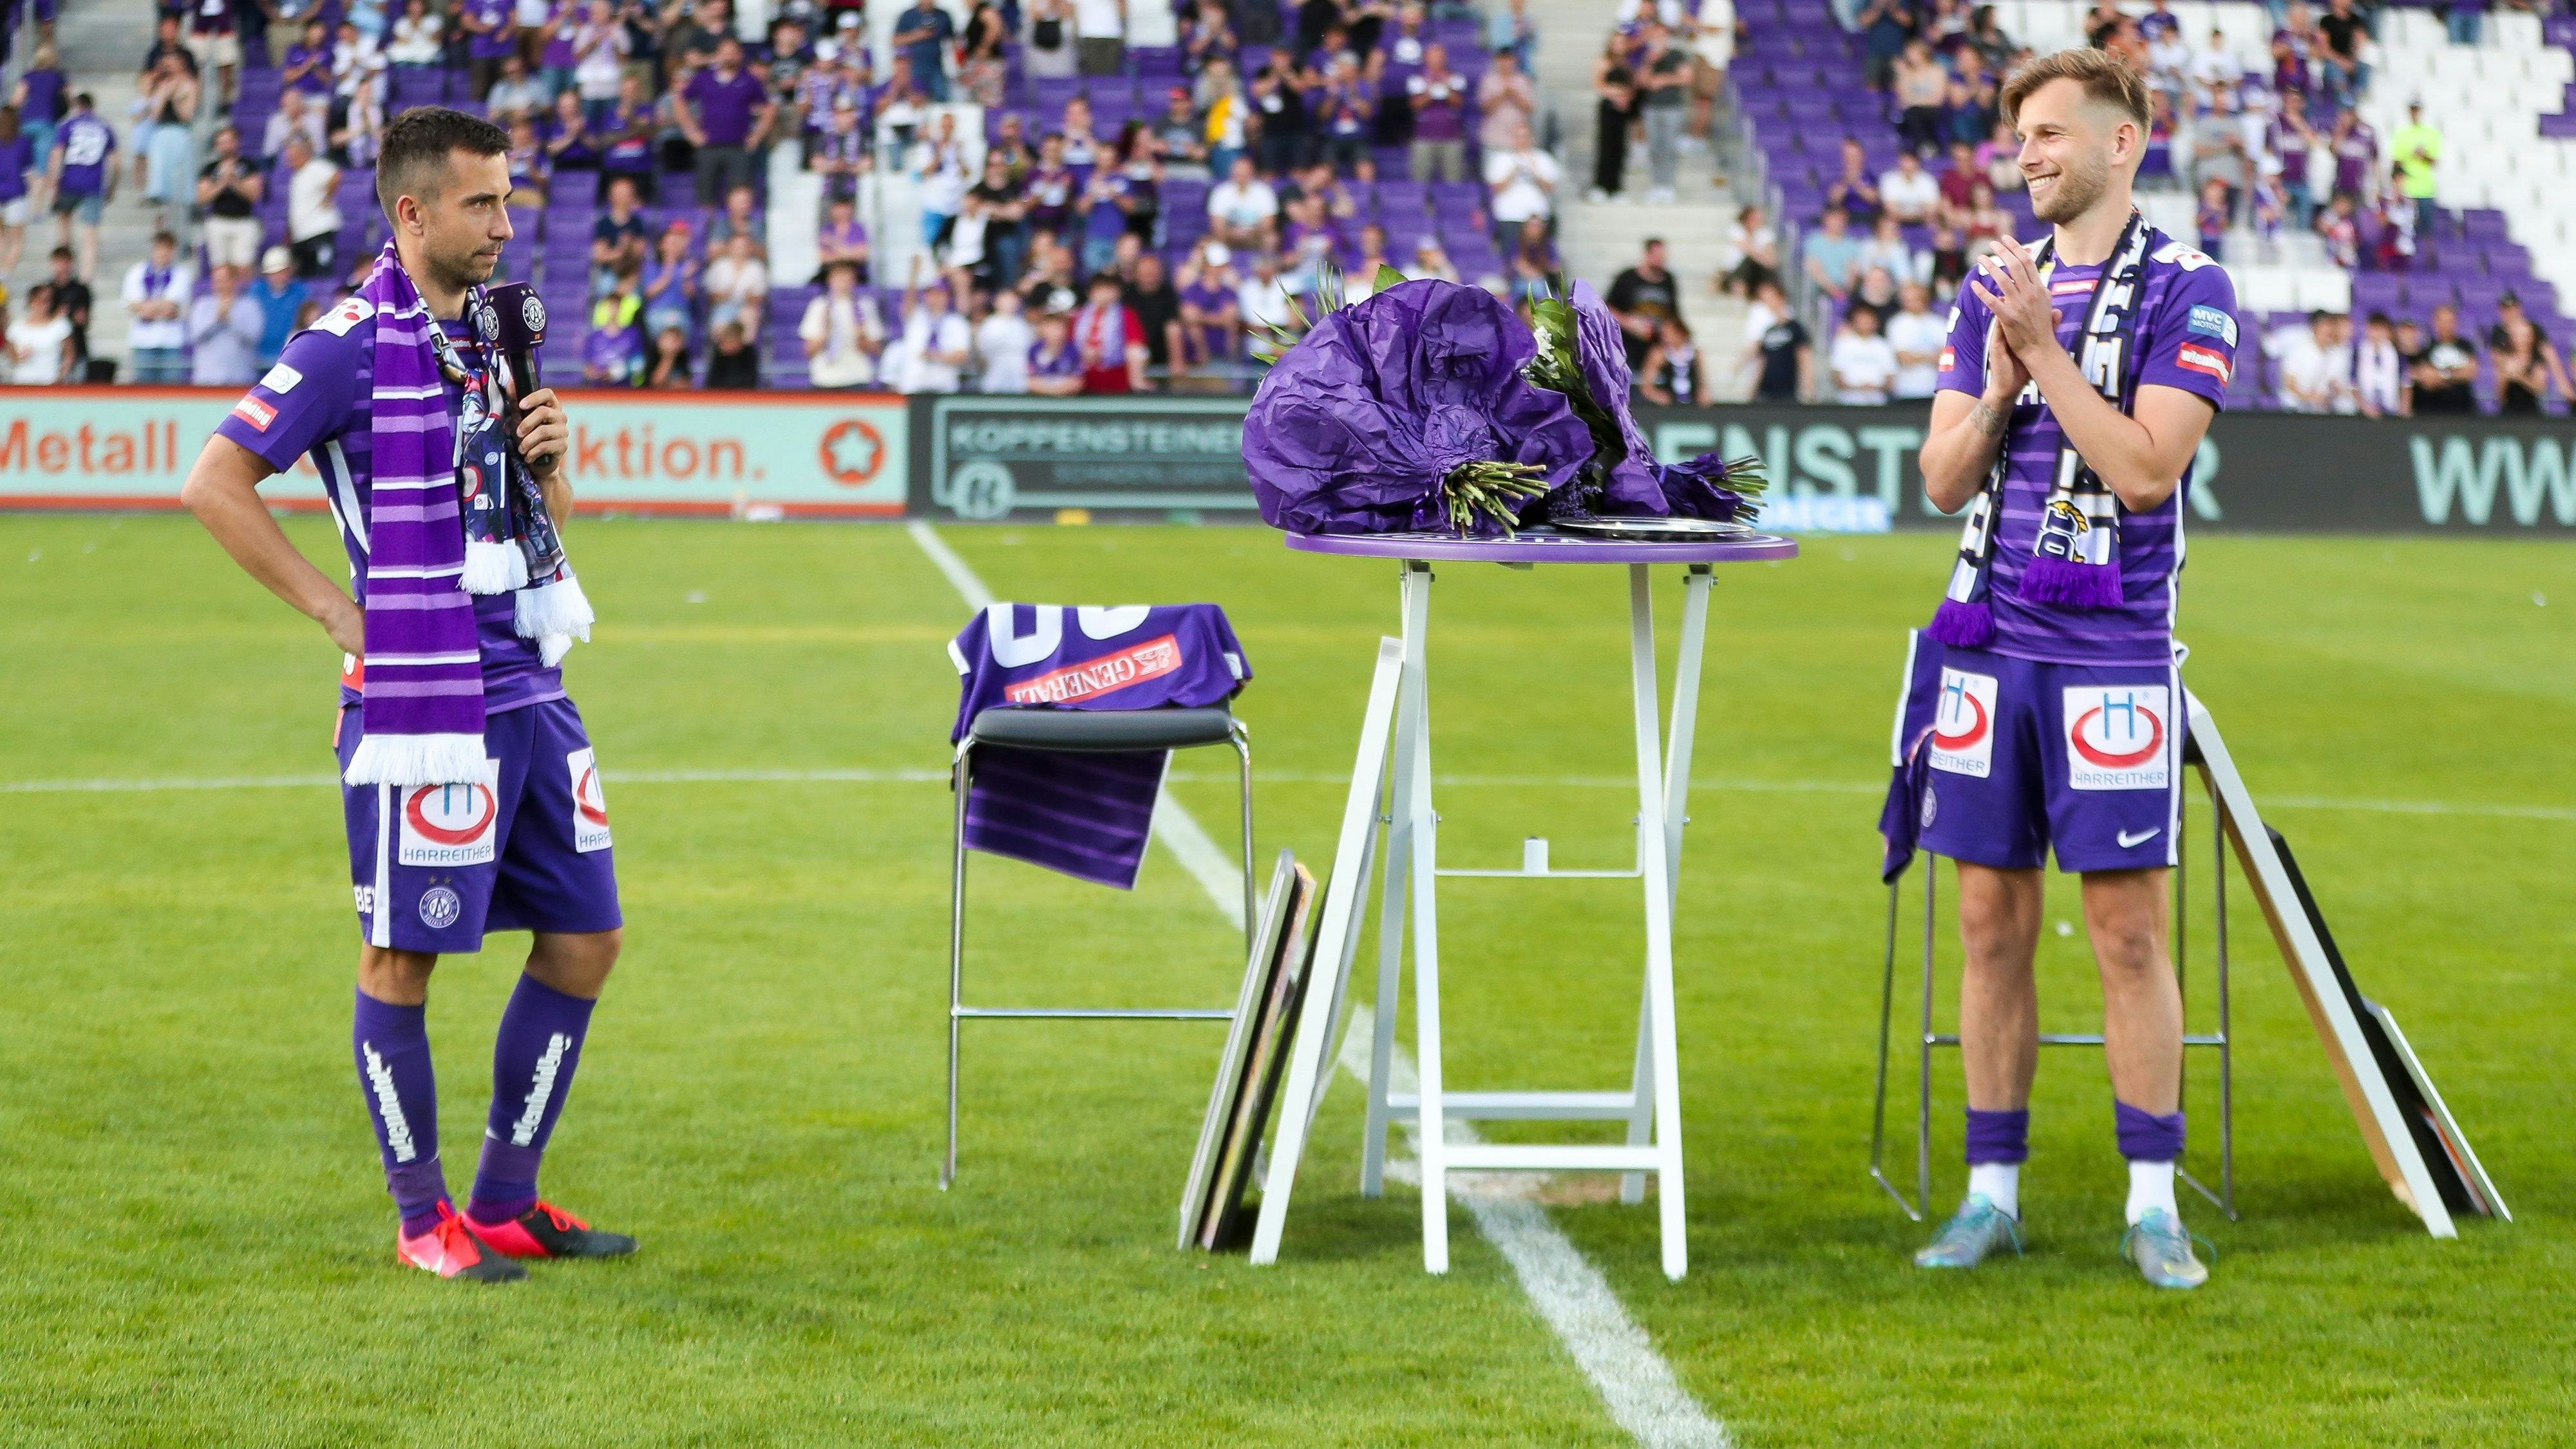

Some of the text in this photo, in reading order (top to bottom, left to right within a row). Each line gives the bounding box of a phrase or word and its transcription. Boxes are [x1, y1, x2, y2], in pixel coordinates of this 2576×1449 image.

[2193, 308, 2223, 325] MVC
[951, 421, 1244, 453] KOPPENSTEINE
[559, 422, 767, 480] ktion.
[1012, 656, 1137, 703] GENERALI
[1931, 751, 1986, 773] REITHER
[2075, 772, 2165, 786] HARREITHER
[404, 845, 492, 862] HARREITHER
